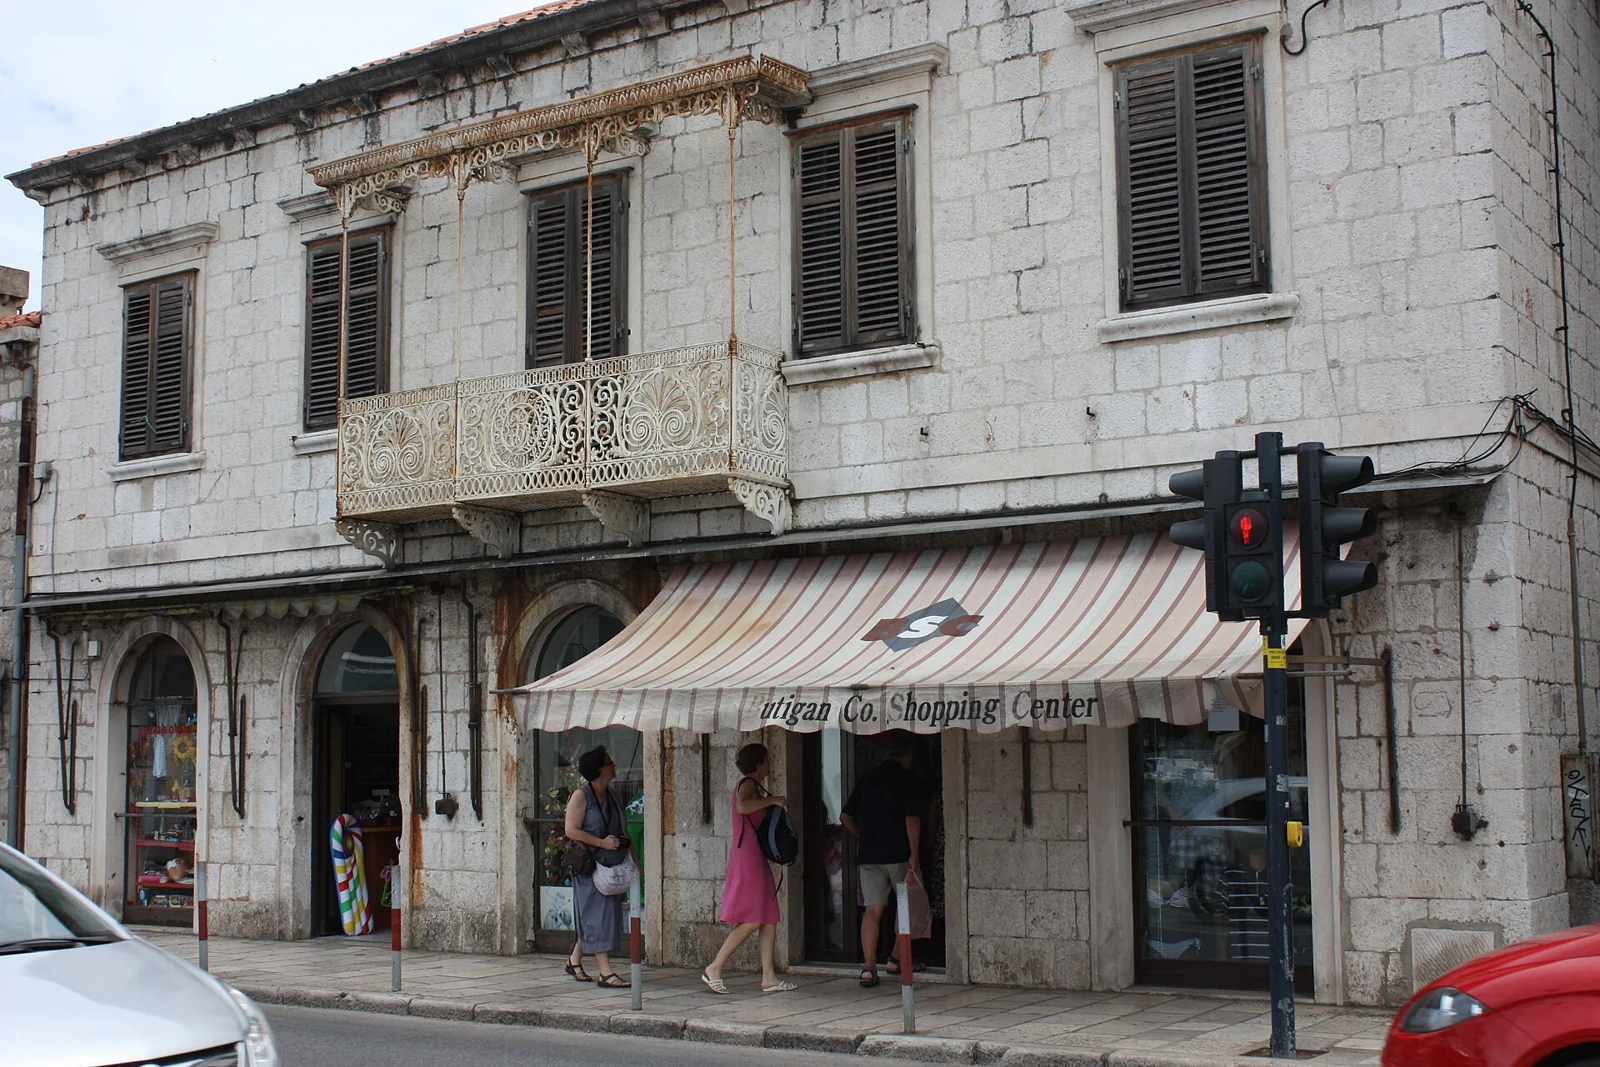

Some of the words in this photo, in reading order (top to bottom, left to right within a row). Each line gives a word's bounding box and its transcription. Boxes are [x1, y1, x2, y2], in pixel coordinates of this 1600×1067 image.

[843, 694, 878, 723] Co.
[888, 691, 1001, 727] Shopping
[1012, 690, 1099, 721] Center
